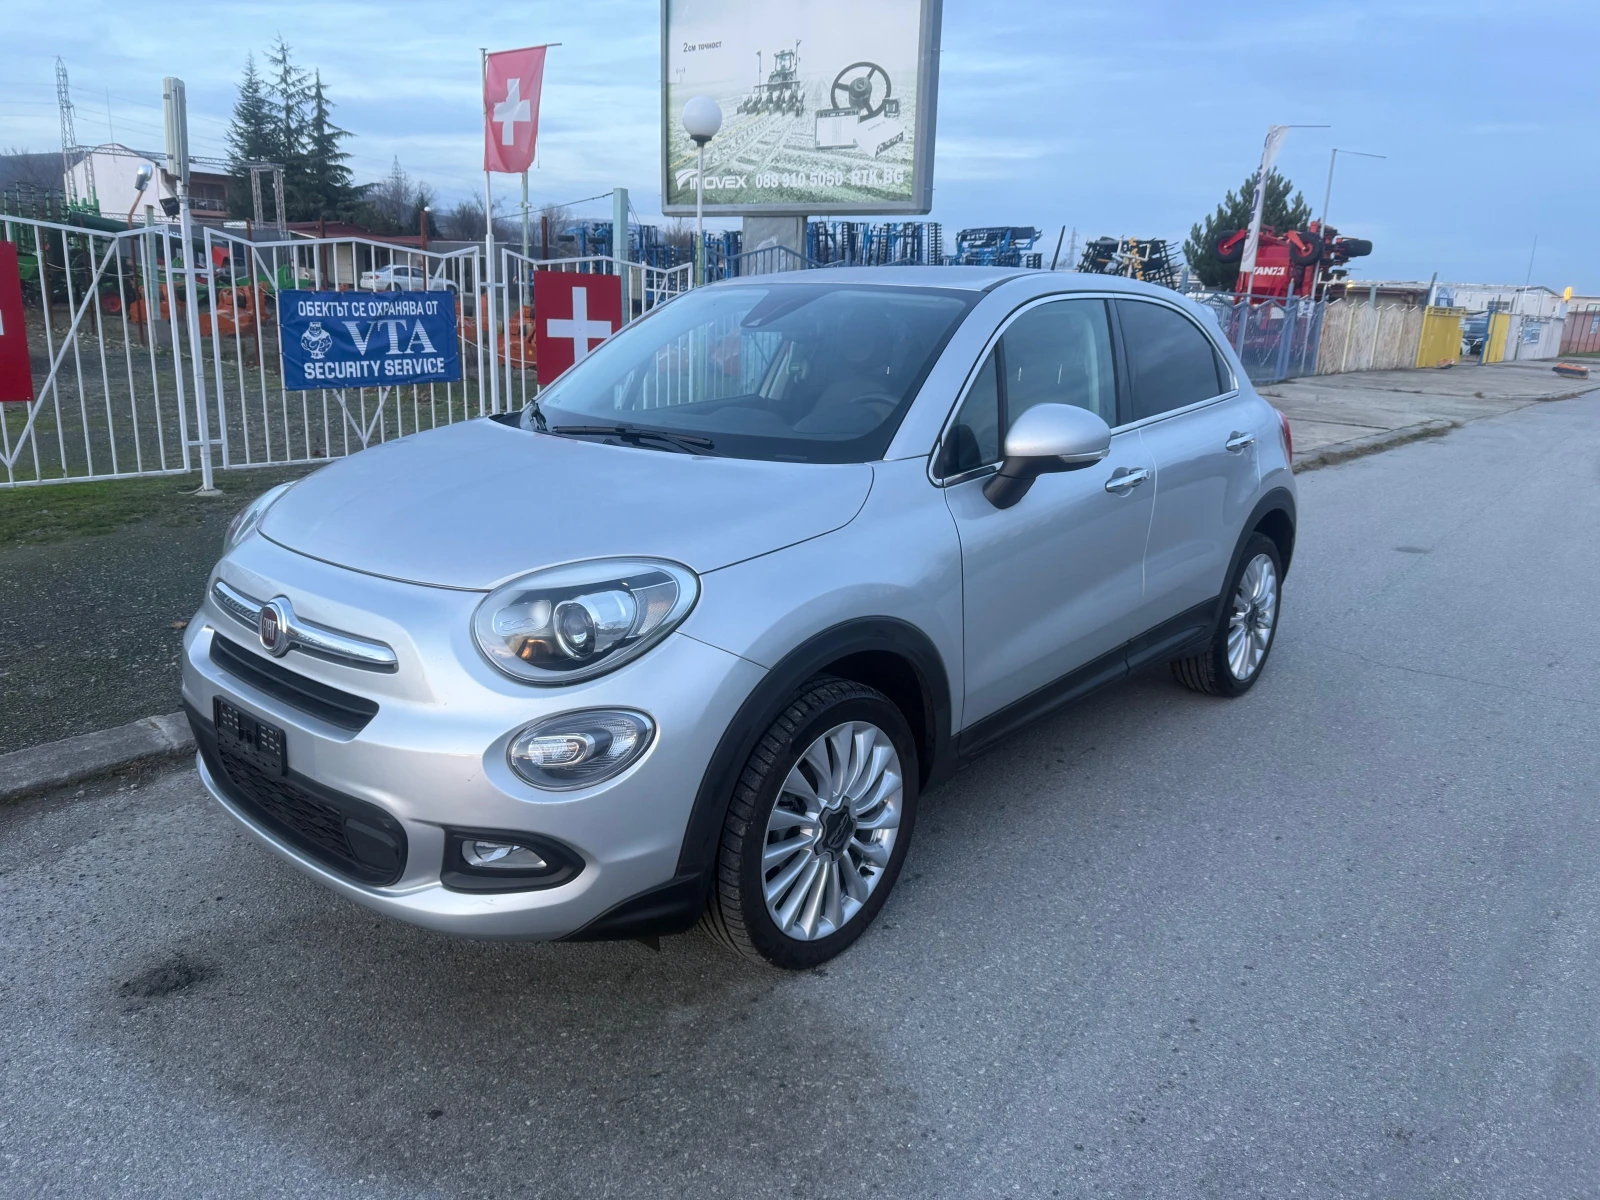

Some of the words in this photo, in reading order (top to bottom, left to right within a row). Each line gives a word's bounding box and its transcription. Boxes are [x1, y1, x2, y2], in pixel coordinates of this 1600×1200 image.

[755, 173, 779, 189] 088
[781, 172, 806, 188] 910
[809, 170, 843, 187] 5050
[851, 168, 904, 186] RTK.BG
[298, 301, 349, 316] ОБЕКТЪТ
[351, 302, 366, 316] СЕ
[368, 301, 424, 316] ОХРАНЯВА
[426, 301, 438, 315] ОТ
[341, 318, 437, 356] VTA
[304, 360, 380, 379] SECURITY
[384, 357, 445, 376] SERVICE
[263, 617, 276, 640] FIAT
